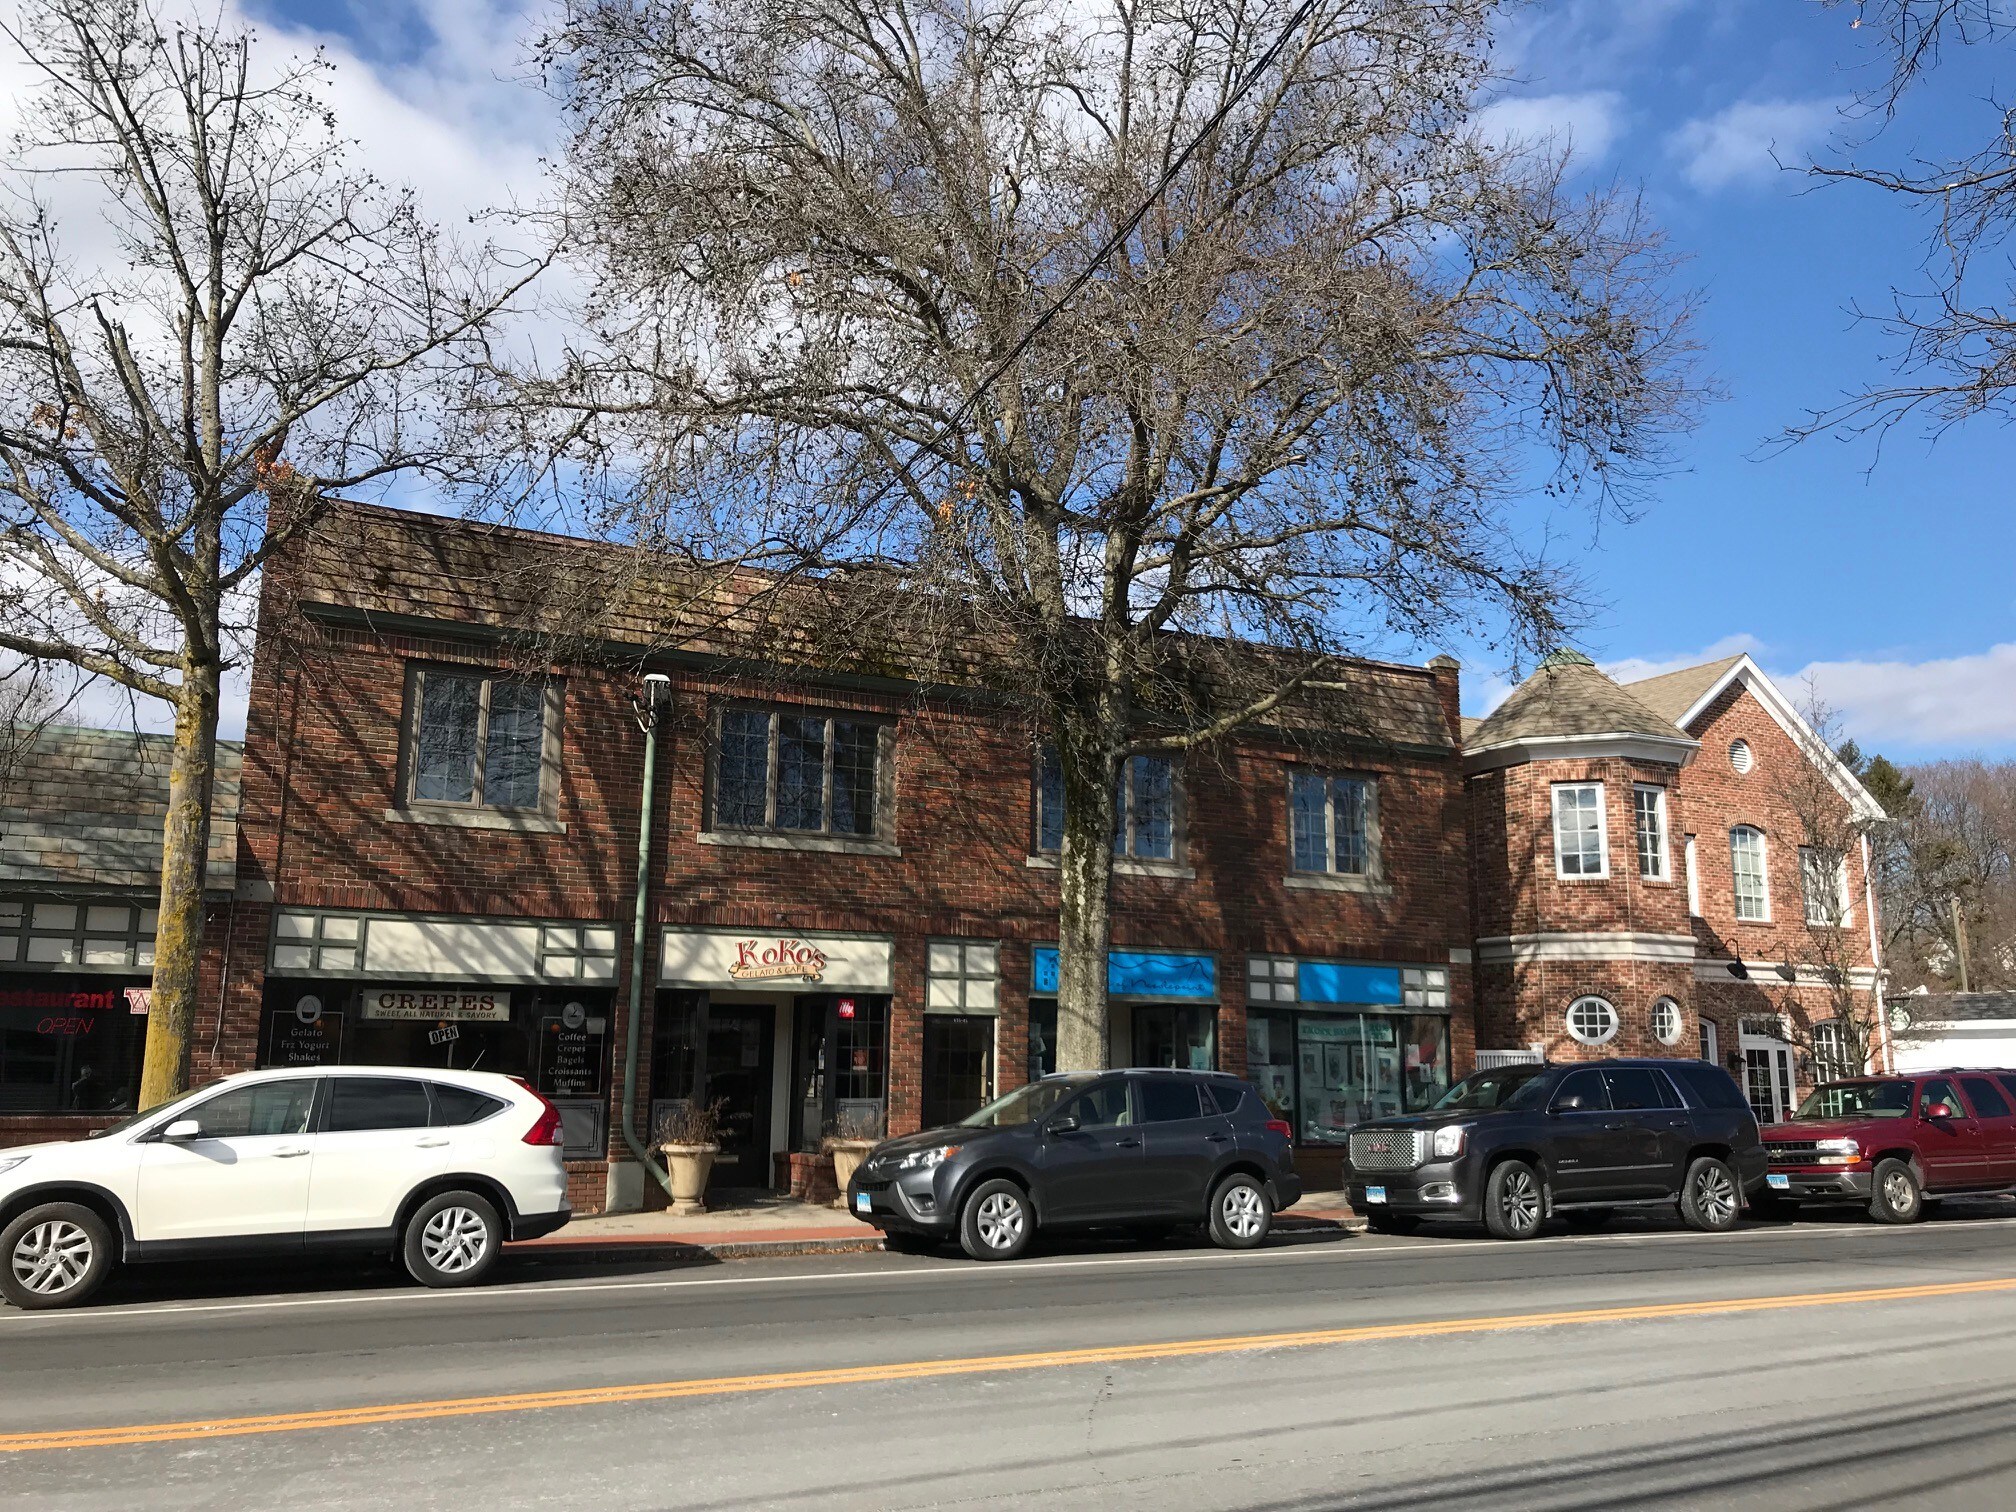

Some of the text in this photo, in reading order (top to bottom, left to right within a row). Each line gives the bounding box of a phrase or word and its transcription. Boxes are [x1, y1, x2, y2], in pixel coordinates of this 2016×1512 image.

[741, 968, 775, 978] GELATO
[378, 993, 495, 1011] CREPES
[36, 1017, 94, 1034] OPEN
[291, 1028, 323, 1037] Gelato
[431, 1026, 458, 1042] OPEN
[558, 1032, 586, 1041] Coffee
[299, 1040, 330, 1051] Yogurt
[557, 1045, 586, 1054] Crepes
[288, 1052, 321, 1061] Shakes
[557, 1055, 585, 1065] Bagels
[548, 1067, 592, 1075] Croissants
[553, 1078, 586, 1087] Muffins
